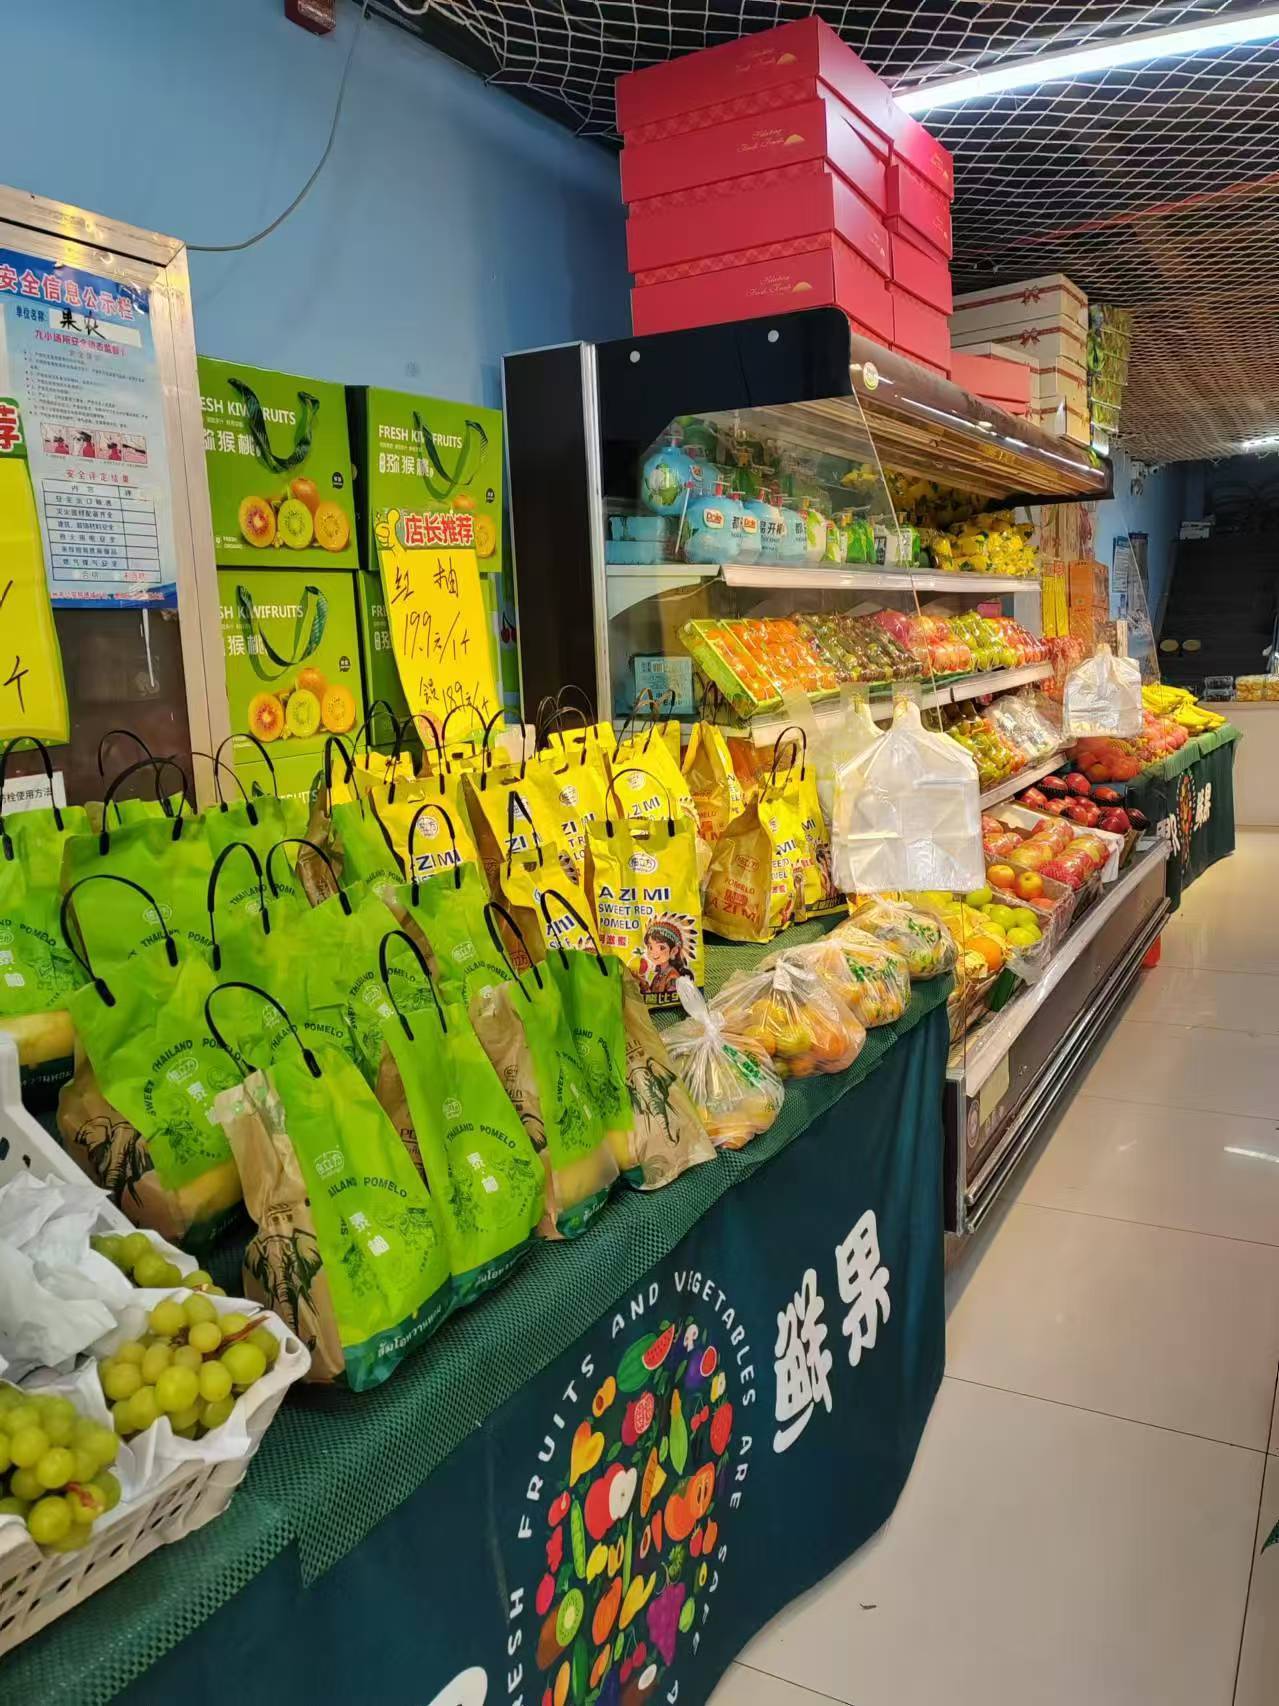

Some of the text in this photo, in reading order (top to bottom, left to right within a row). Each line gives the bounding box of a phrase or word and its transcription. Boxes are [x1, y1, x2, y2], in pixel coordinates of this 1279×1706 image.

[0, 264, 133, 320] 安全信息公示栏
[379, 425, 408, 441] FRESH
[405, 514, 473, 545] 店长推荐
[599, 903, 653, 916] SWEET RED
[304, 1022, 344, 1039] POMELO
[152, 1039, 193, 1073] THAILAND
[480, 1124, 516, 1149] POMELO
[364, 1176, 408, 1198] POMELO
[517, 1353, 596, 1541] FRUITS
[610, 1281, 660, 1340] AND
[673, 1270, 757, 1407] VIGETABLES
[729, 1434, 755, 1511] ARE
